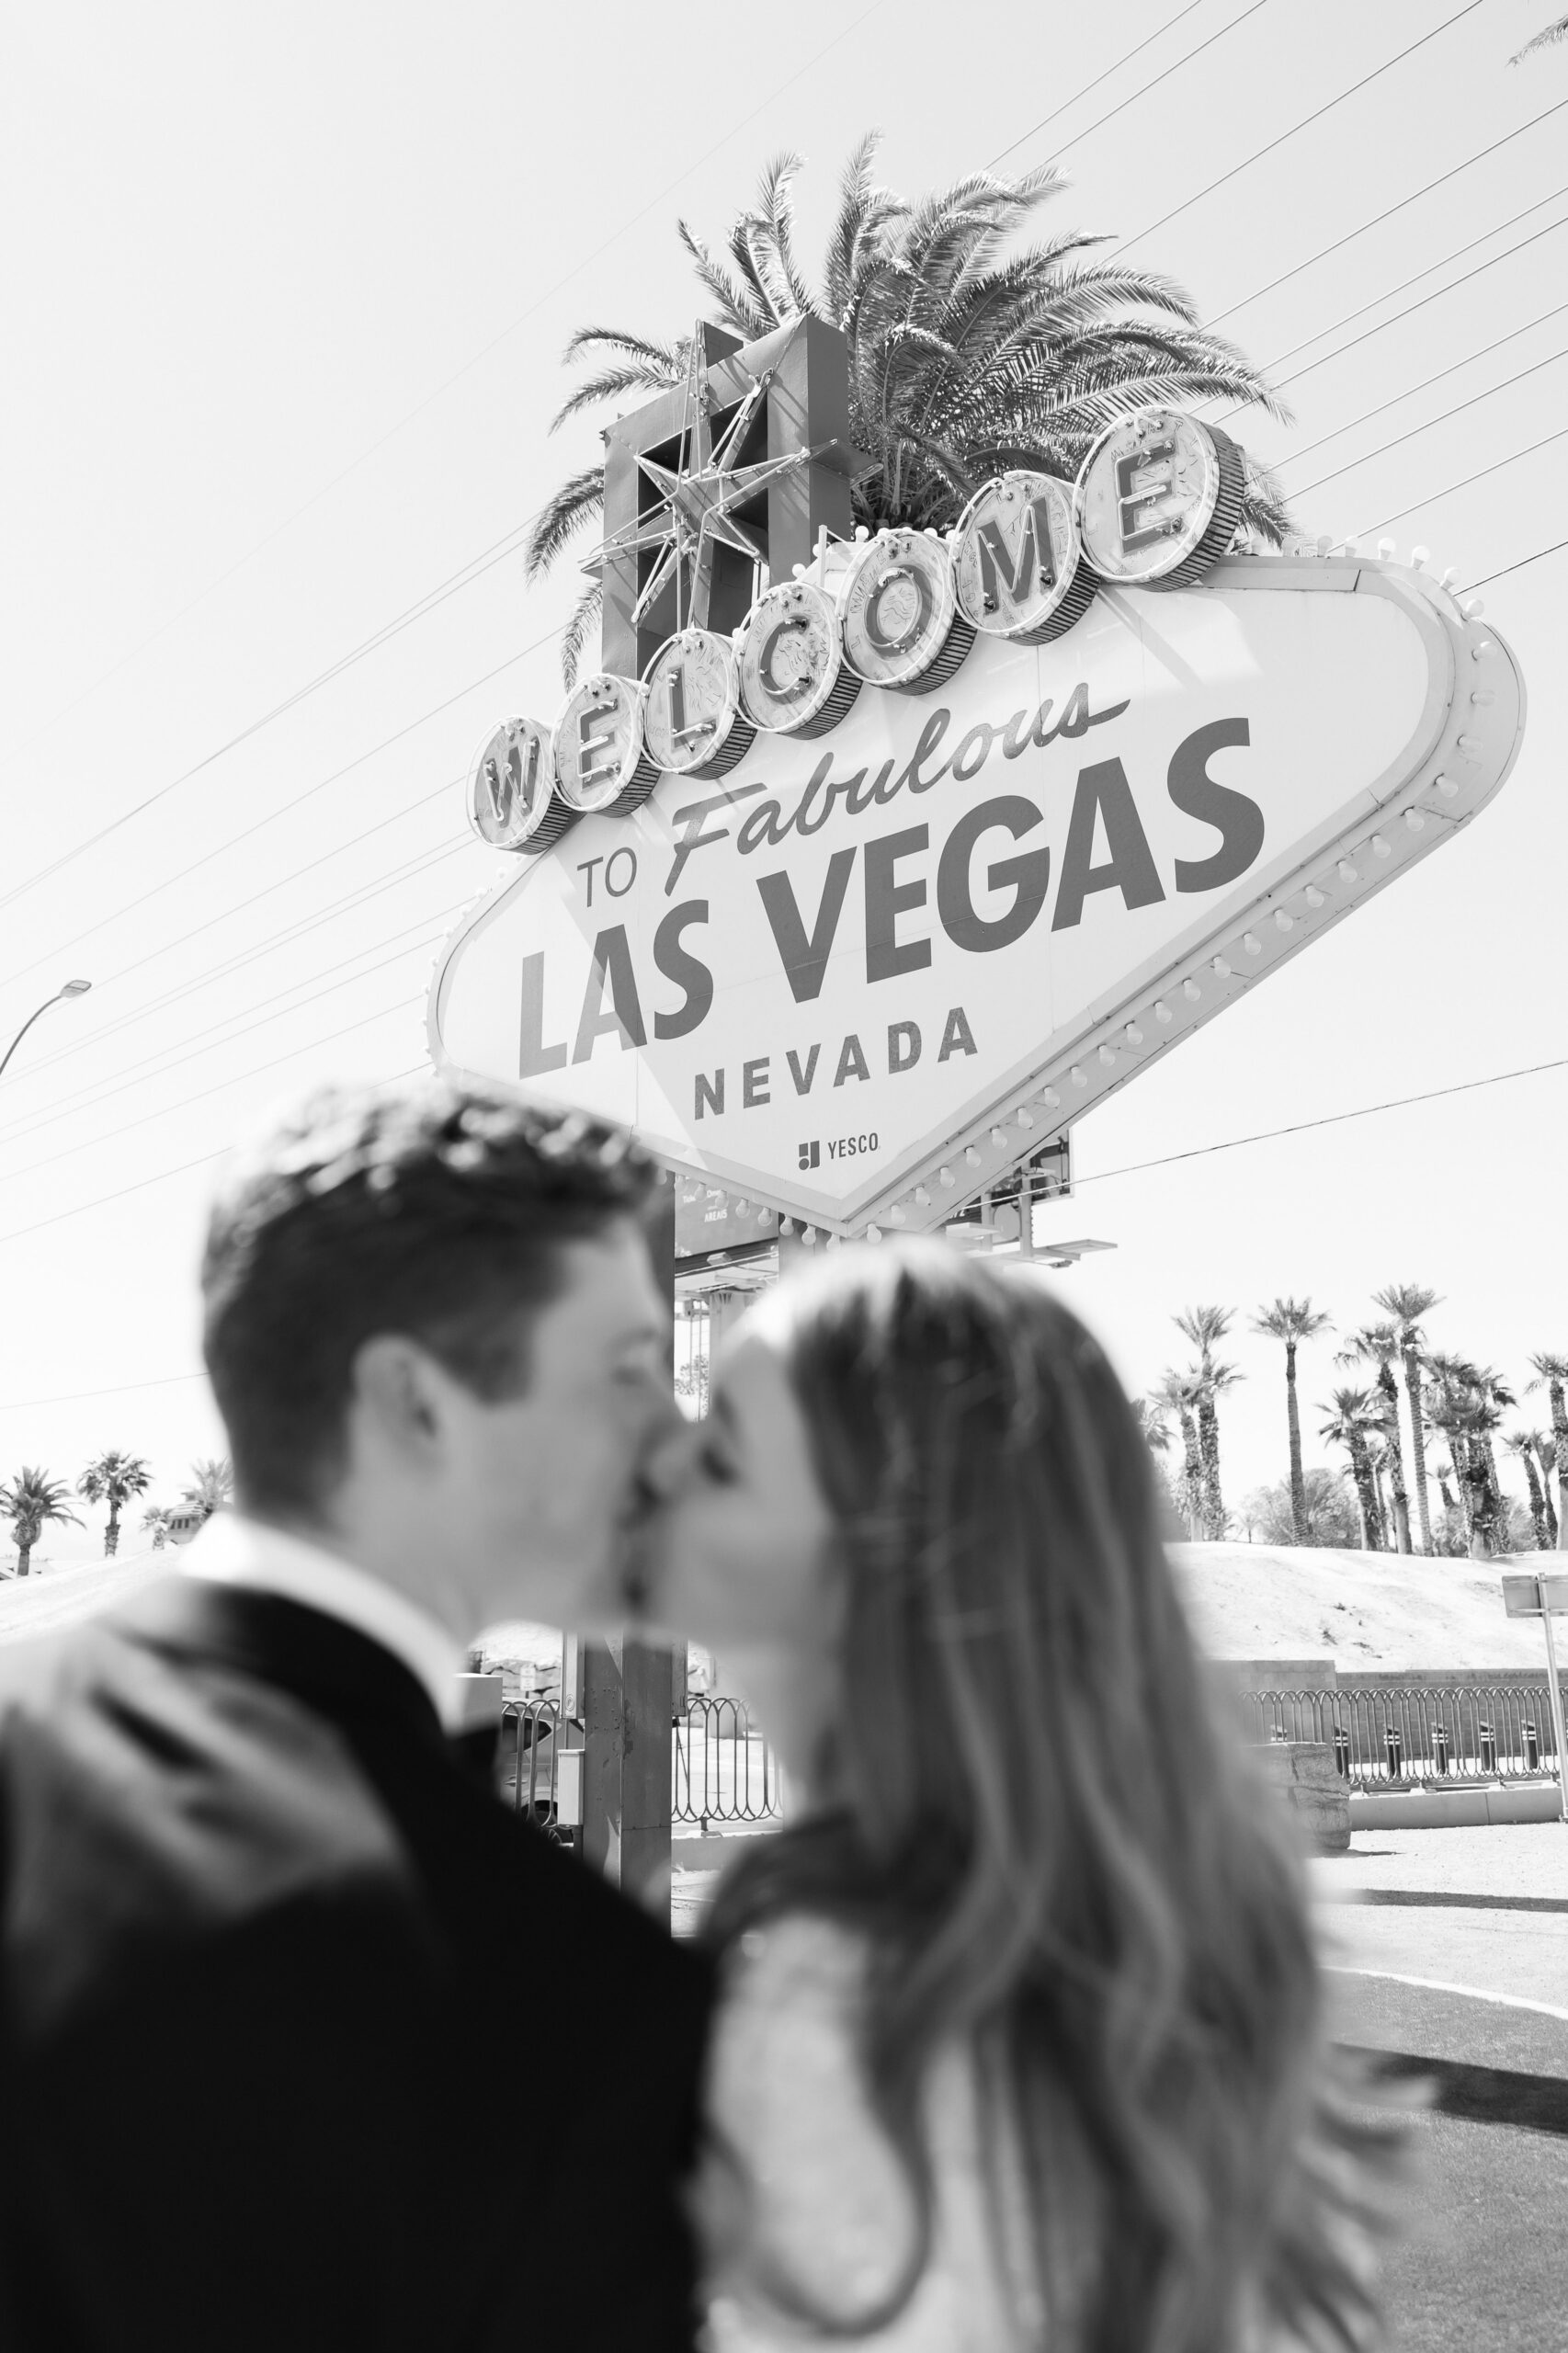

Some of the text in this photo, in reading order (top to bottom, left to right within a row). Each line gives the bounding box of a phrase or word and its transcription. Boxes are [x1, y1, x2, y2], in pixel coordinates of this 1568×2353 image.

[484, 436, 1181, 826] WELCOME
[518, 717, 1267, 1079] LAS VEGAS
[577, 682, 1131, 908] TO Fabulous
[695, 1006, 978, 1120] NEVADA
[827, 1132, 879, 1160] YESCO
